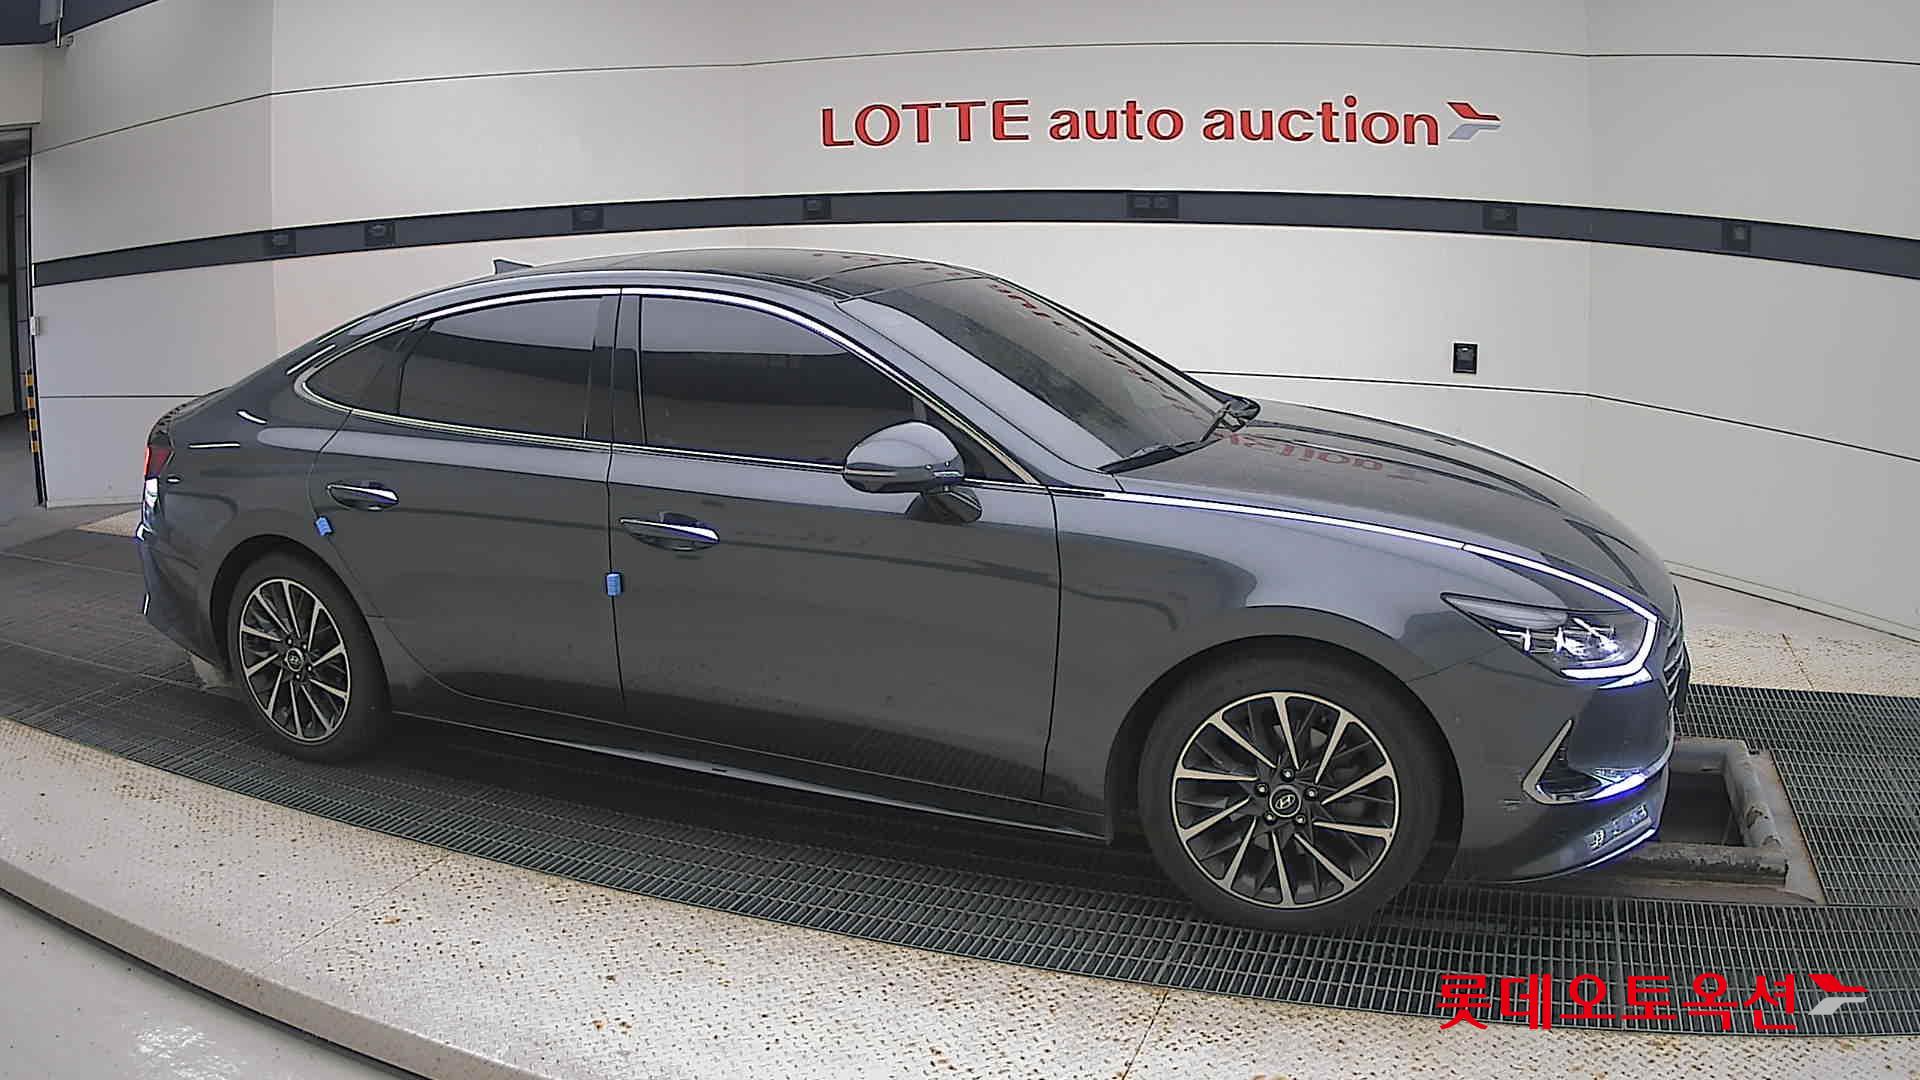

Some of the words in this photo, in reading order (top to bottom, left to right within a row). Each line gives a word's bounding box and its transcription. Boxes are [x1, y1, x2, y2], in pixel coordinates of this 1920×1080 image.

[822, 99, 1030, 147] LOTTE
[1050, 100, 1184, 140] auto
[1203, 95, 1440, 146] auction
